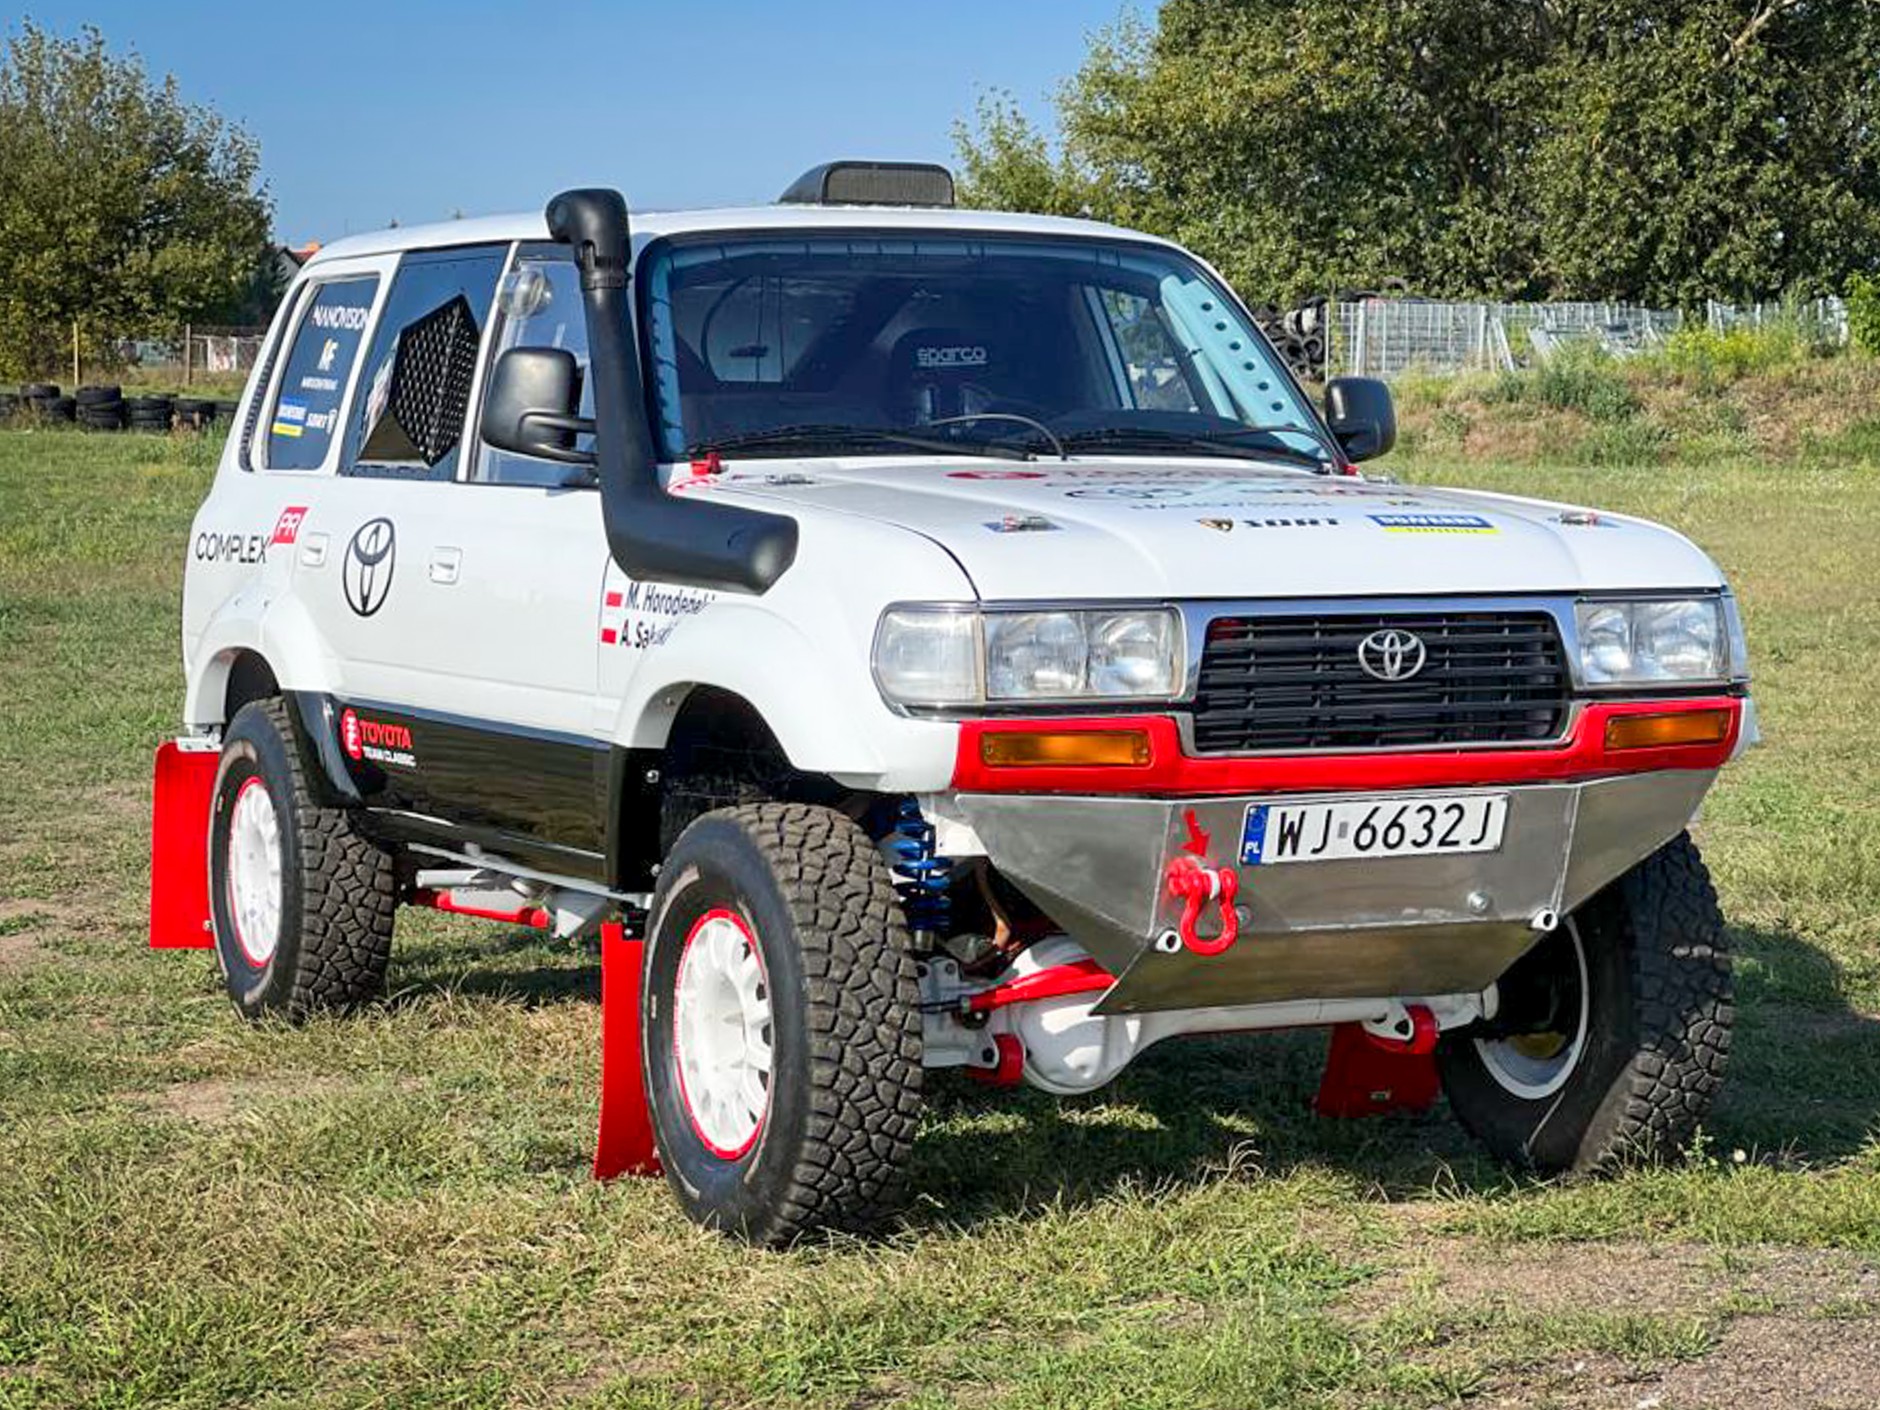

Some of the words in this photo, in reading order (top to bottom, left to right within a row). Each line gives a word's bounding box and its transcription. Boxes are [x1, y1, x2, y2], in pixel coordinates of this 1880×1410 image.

[917, 346, 987, 367] sparco
[276, 512, 301, 538] PR
[195, 532, 269, 563] COMPLEX
[360, 720, 413, 750] TOYOTA
[1277, 809, 1332, 856] WJ
[1353, 802, 1492, 851] 6632J
[1245, 841, 1260, 855] PL
